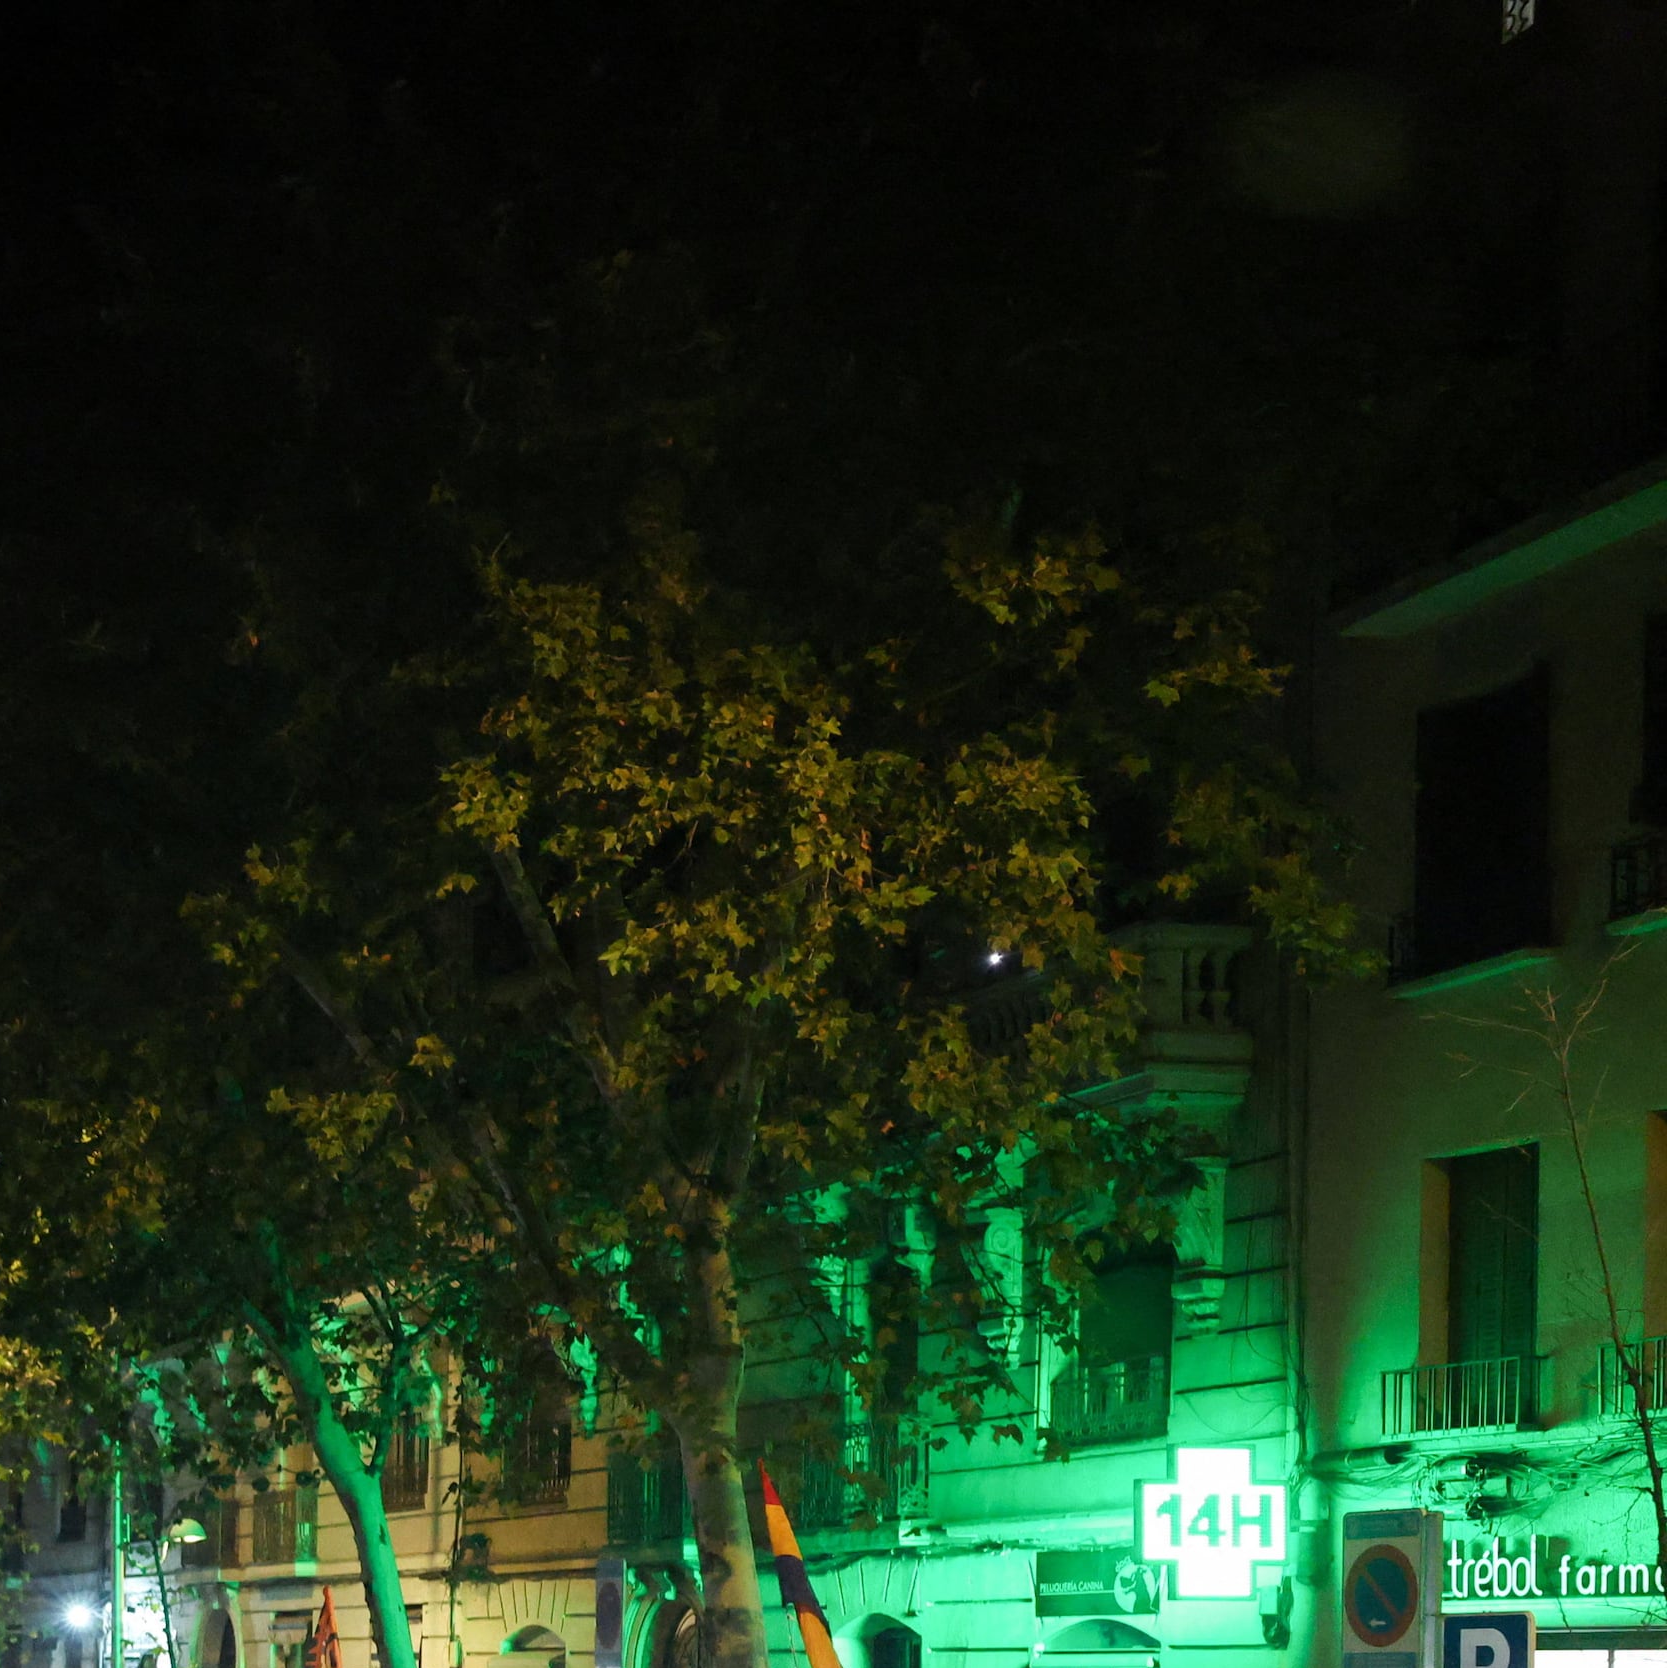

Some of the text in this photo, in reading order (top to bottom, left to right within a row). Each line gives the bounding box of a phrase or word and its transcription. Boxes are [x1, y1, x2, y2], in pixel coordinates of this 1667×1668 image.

[1156, 1494, 1273, 1548] 14H
[1078, 1580, 1104, 1591] CANINA
[1447, 1534, 1543, 1598] trébol
